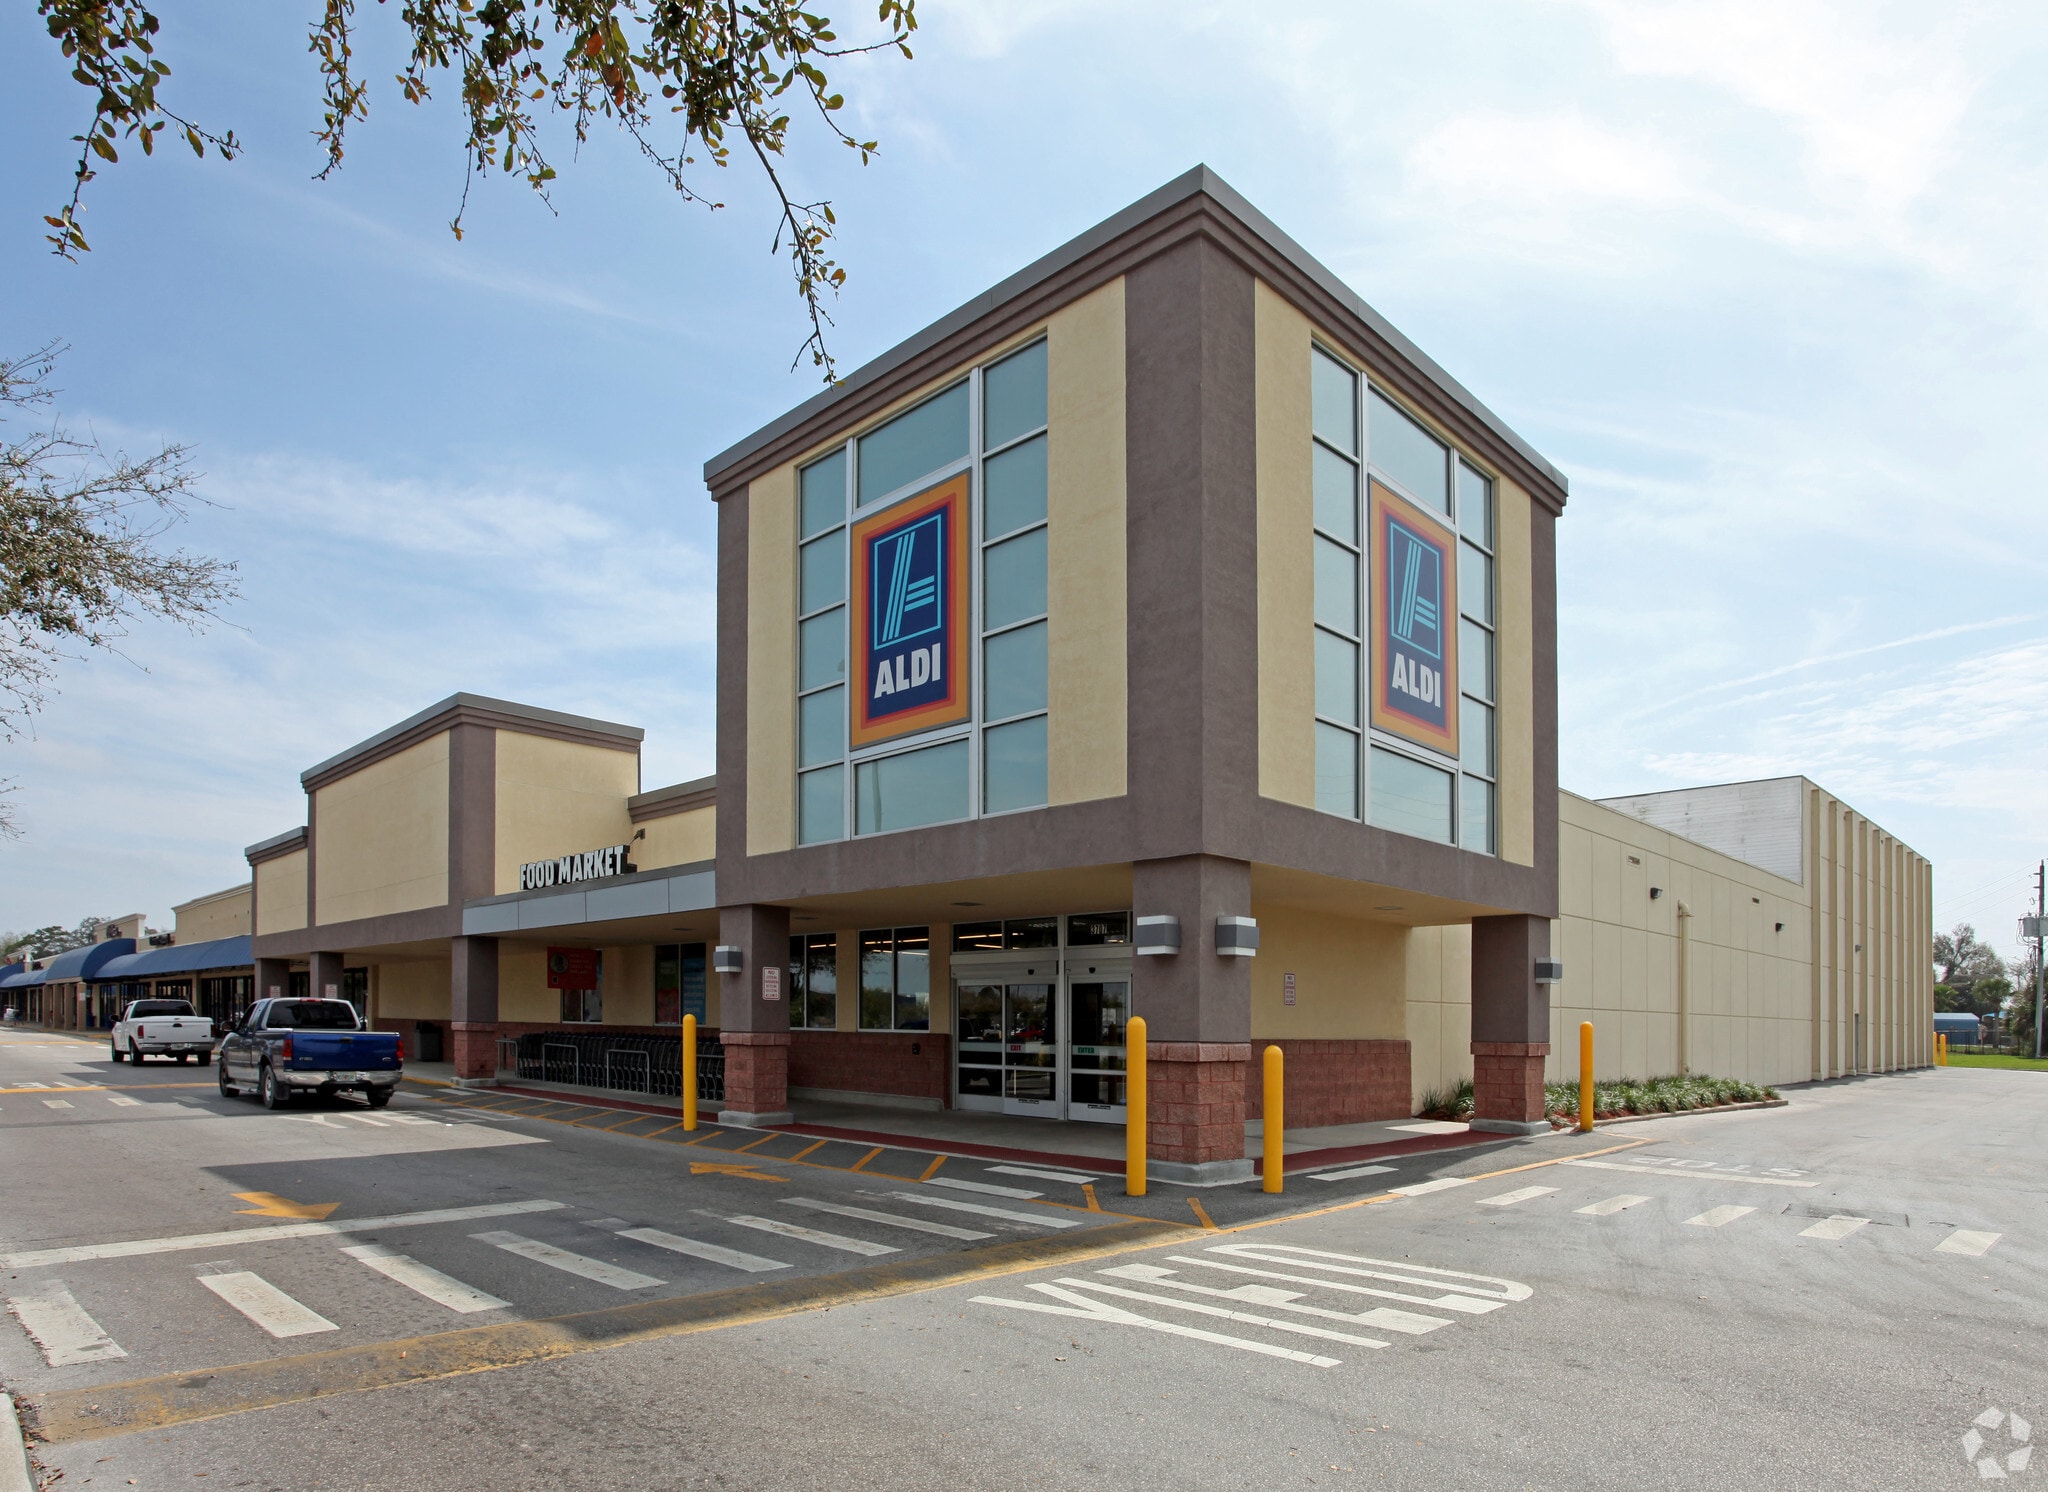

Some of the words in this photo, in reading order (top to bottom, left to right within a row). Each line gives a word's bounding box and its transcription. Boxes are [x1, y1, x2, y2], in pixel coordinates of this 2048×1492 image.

[874, 643, 941, 699] ALDI
[1392, 652, 1441, 708] ALDI
[520, 860, 555, 890] FOOD
[558, 845, 624, 885] MARKET
[1077, 1046, 1095, 1054] ENTER
[1628, 1157, 1811, 1178] STOP
[966, 1243, 1534, 1368] YIELD
